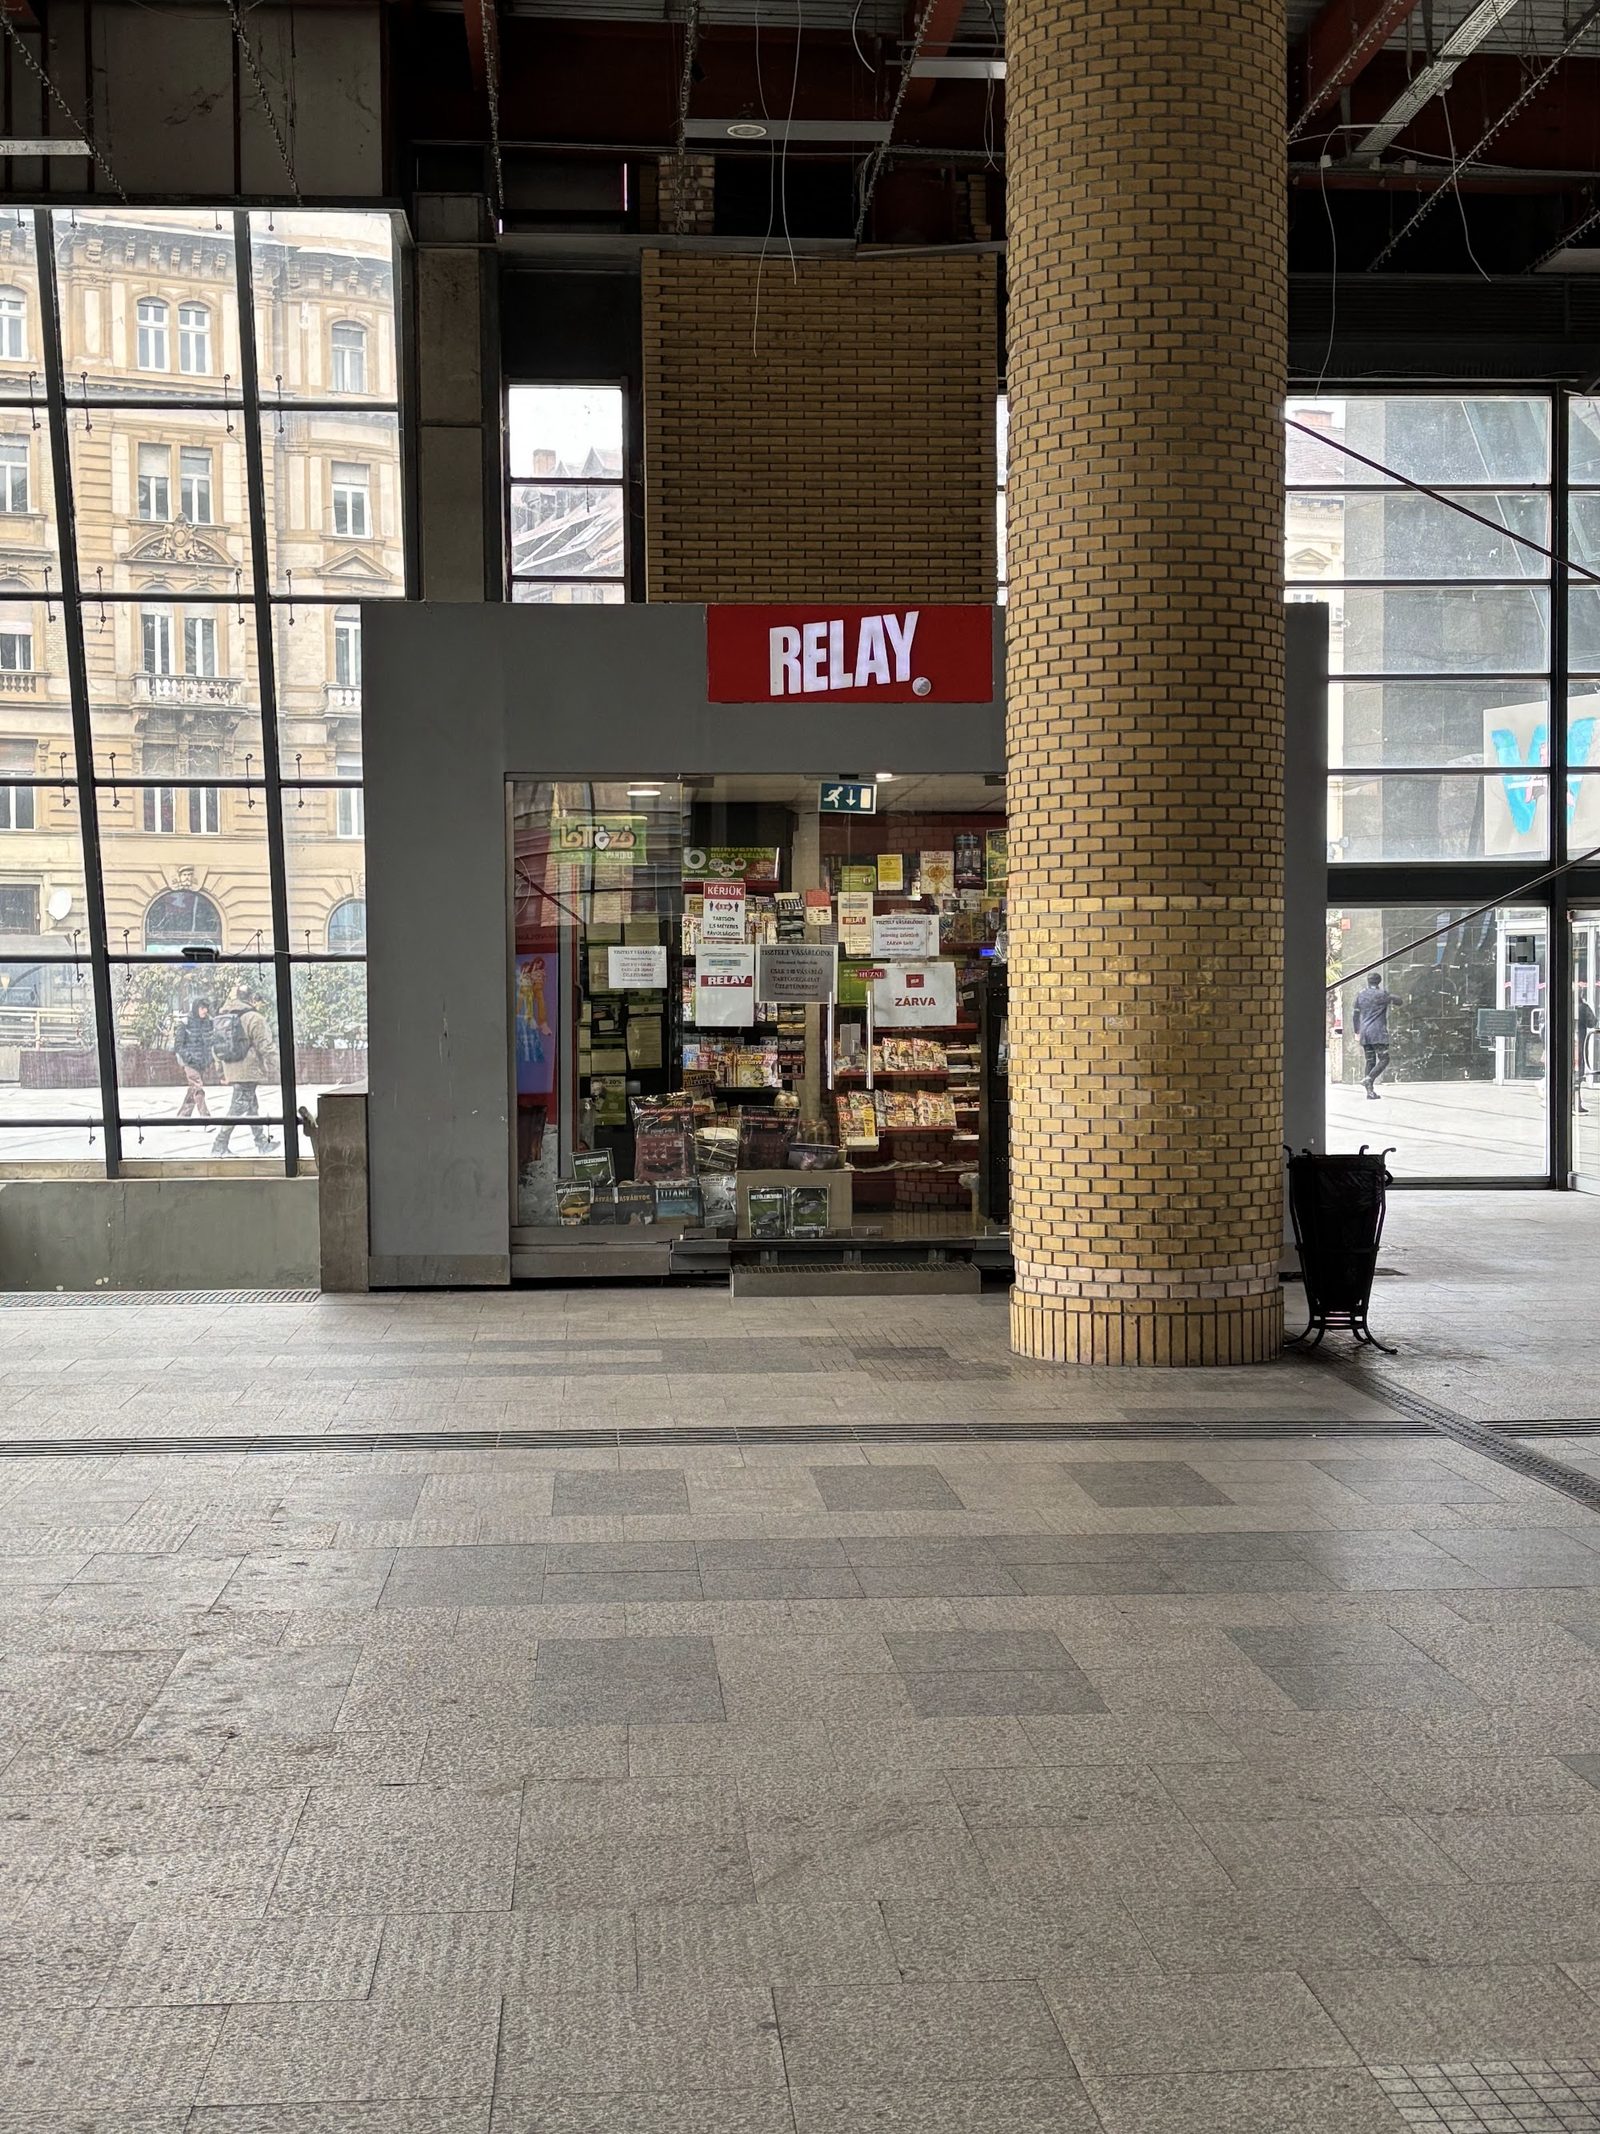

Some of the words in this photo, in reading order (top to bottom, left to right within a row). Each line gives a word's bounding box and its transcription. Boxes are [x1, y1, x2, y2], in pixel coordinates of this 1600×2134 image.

[769, 610, 921, 697] RELAY
[707, 885, 742, 896] KÉRJÜK
[708, 976, 746, 985] RELAY
[895, 996, 936, 1007] ZÁRVA
[660, 1189, 693, 1198] TITANIC
